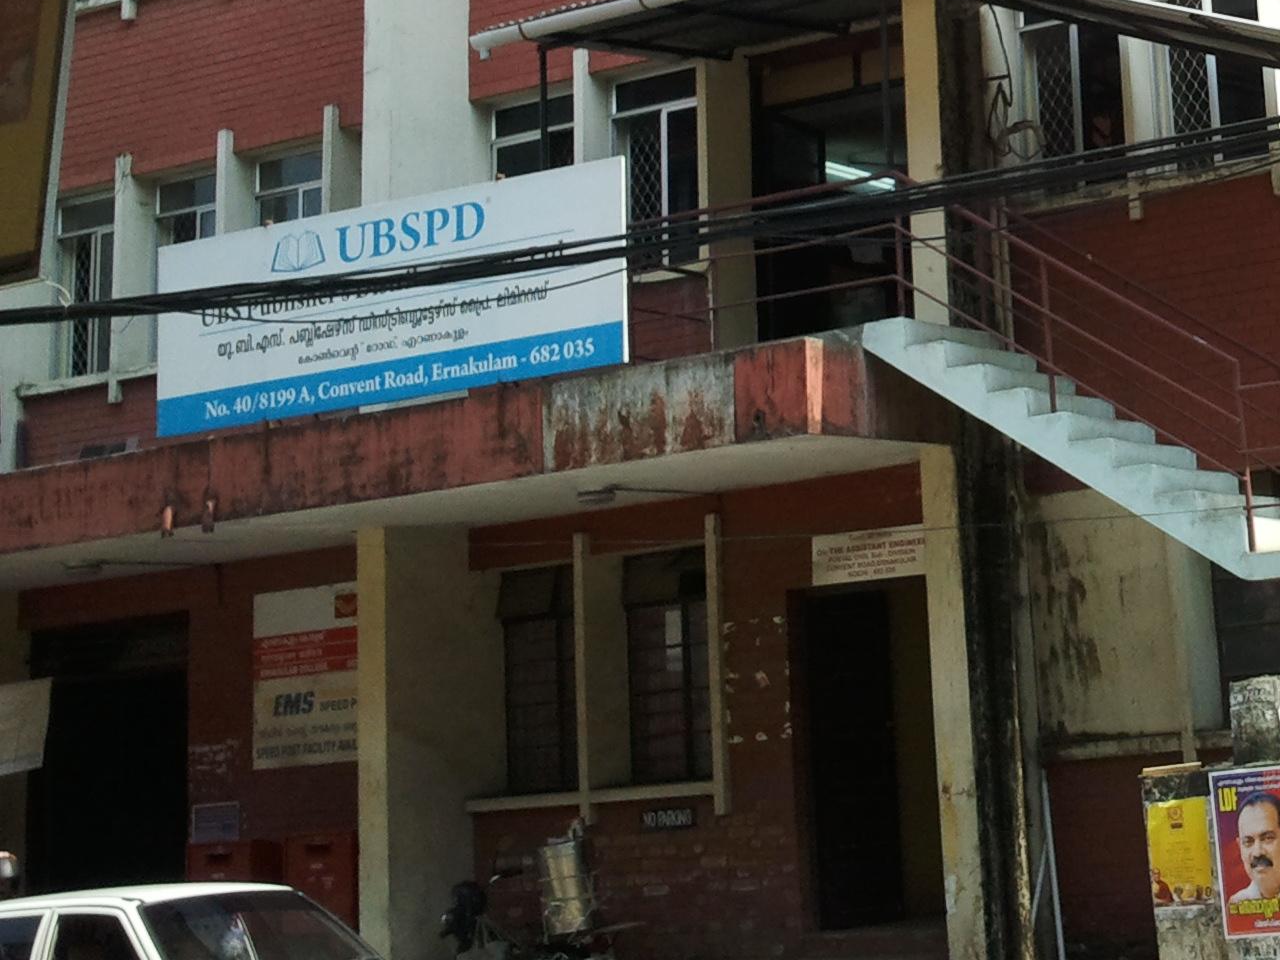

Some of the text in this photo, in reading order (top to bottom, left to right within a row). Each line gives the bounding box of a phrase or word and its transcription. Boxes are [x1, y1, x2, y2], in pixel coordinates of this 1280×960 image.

[335, 201, 486, 264] UBSPD
[204, 399, 230, 420] No.
[233, 387, 296, 414] 40/8199
[299, 385, 316, 405] A,
[318, 375, 381, 399] Convent
[384, 364, 430, 388] Road,
[432, 353, 518, 382] Ernakulam
[530, 343, 561, 365] 682
[563, 337, 596, 359] 035
[272, 690, 316, 718] EMS
[1217, 786, 1238, 813] LDF
